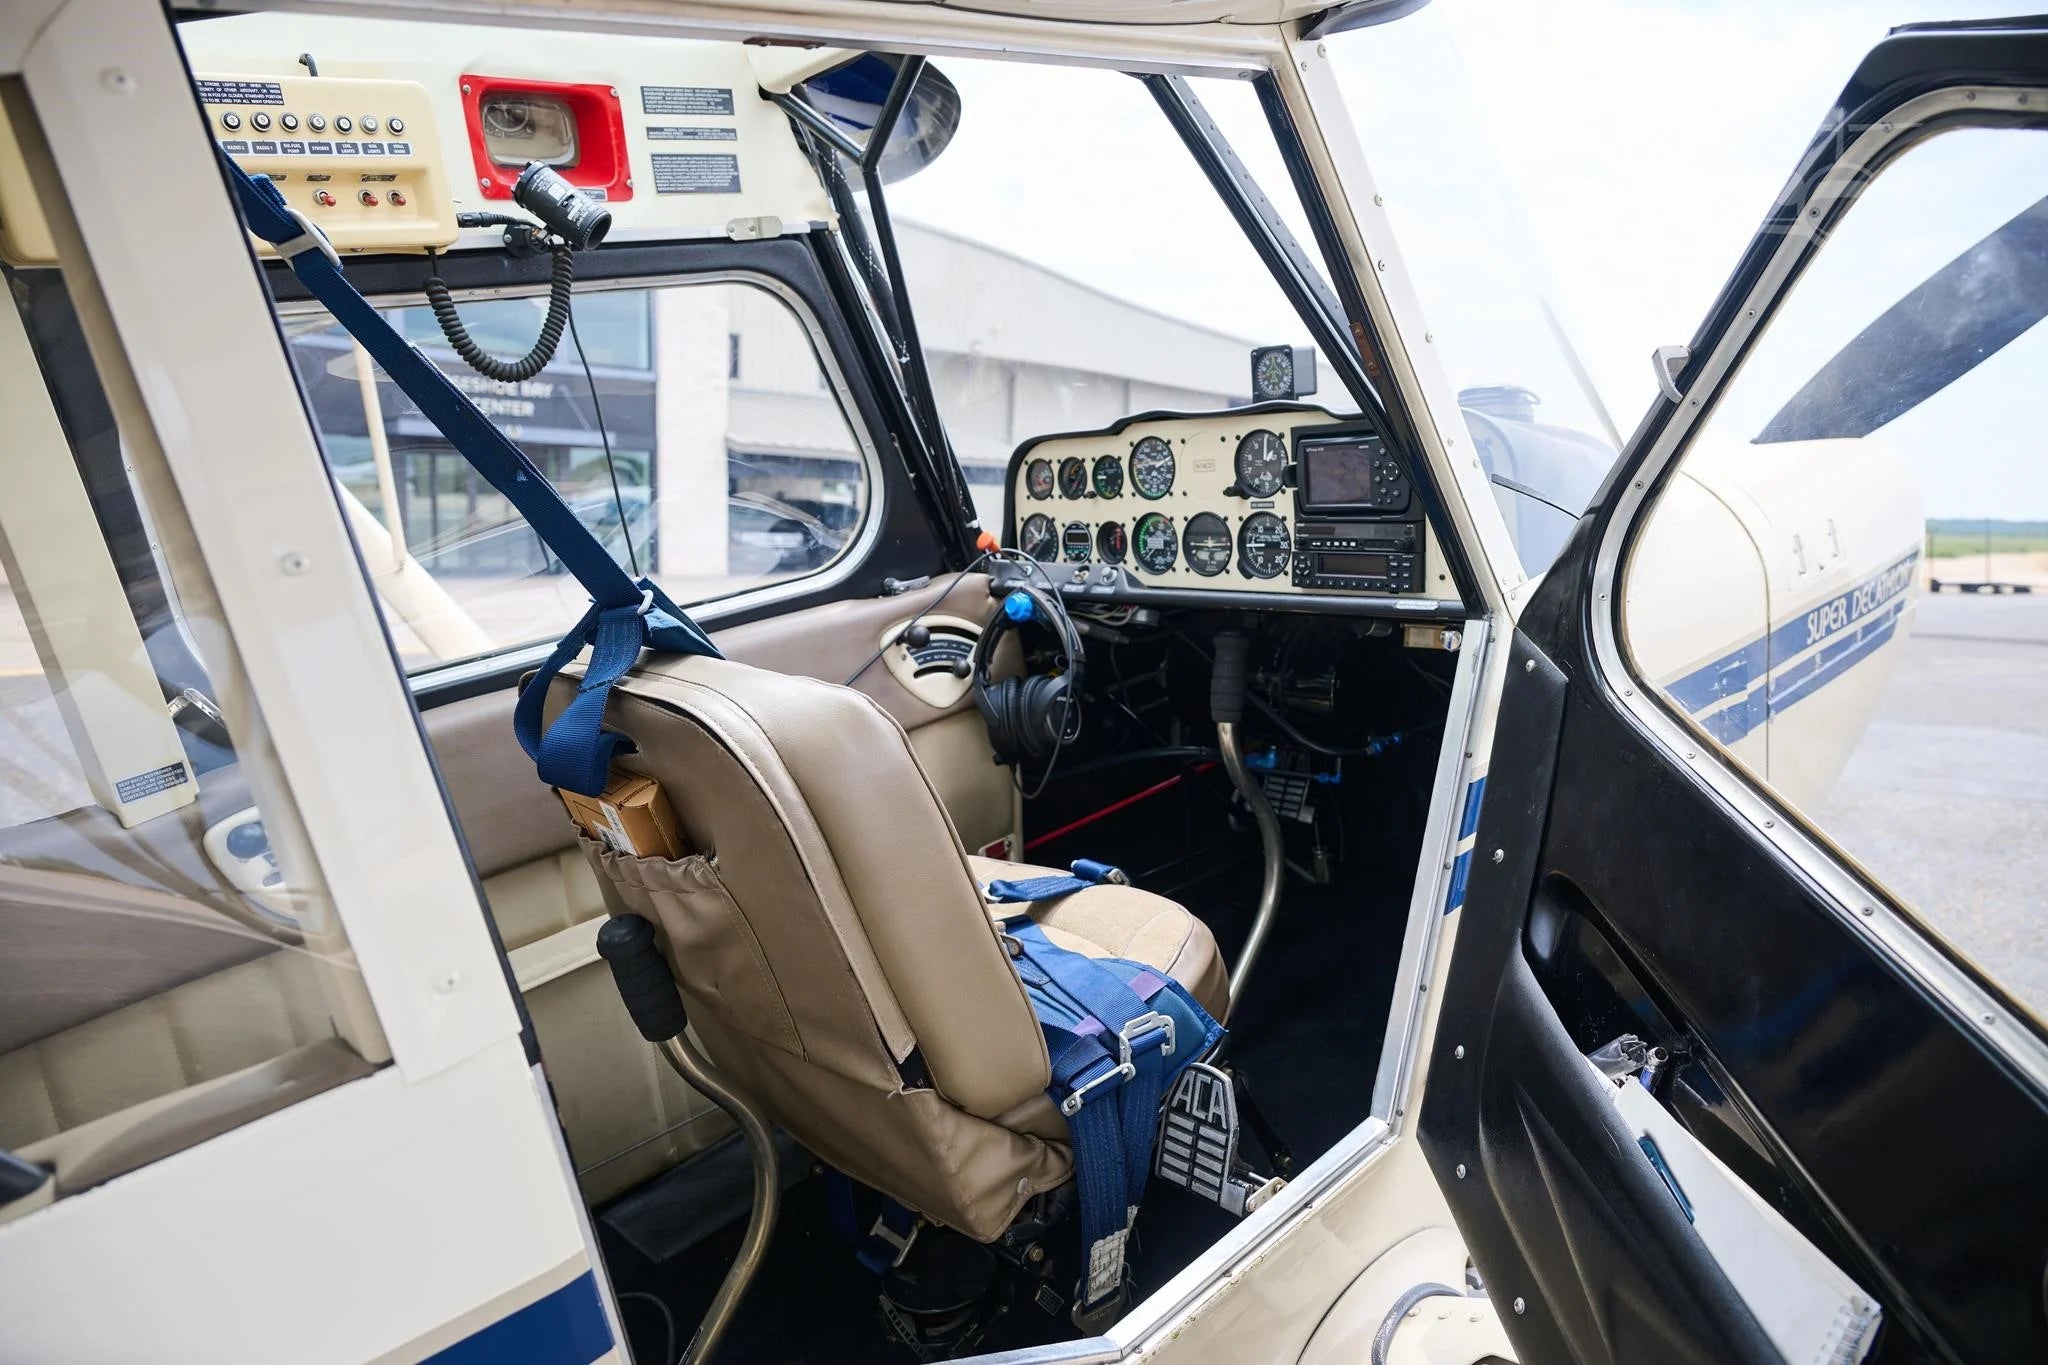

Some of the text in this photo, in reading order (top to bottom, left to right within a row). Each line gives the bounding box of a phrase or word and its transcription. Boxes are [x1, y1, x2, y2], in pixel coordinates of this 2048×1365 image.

[1806, 597, 1847, 645] SUPER
[156, 768, 184, 780] CONNECTED
[1171, 1071, 1227, 1129] ACA
